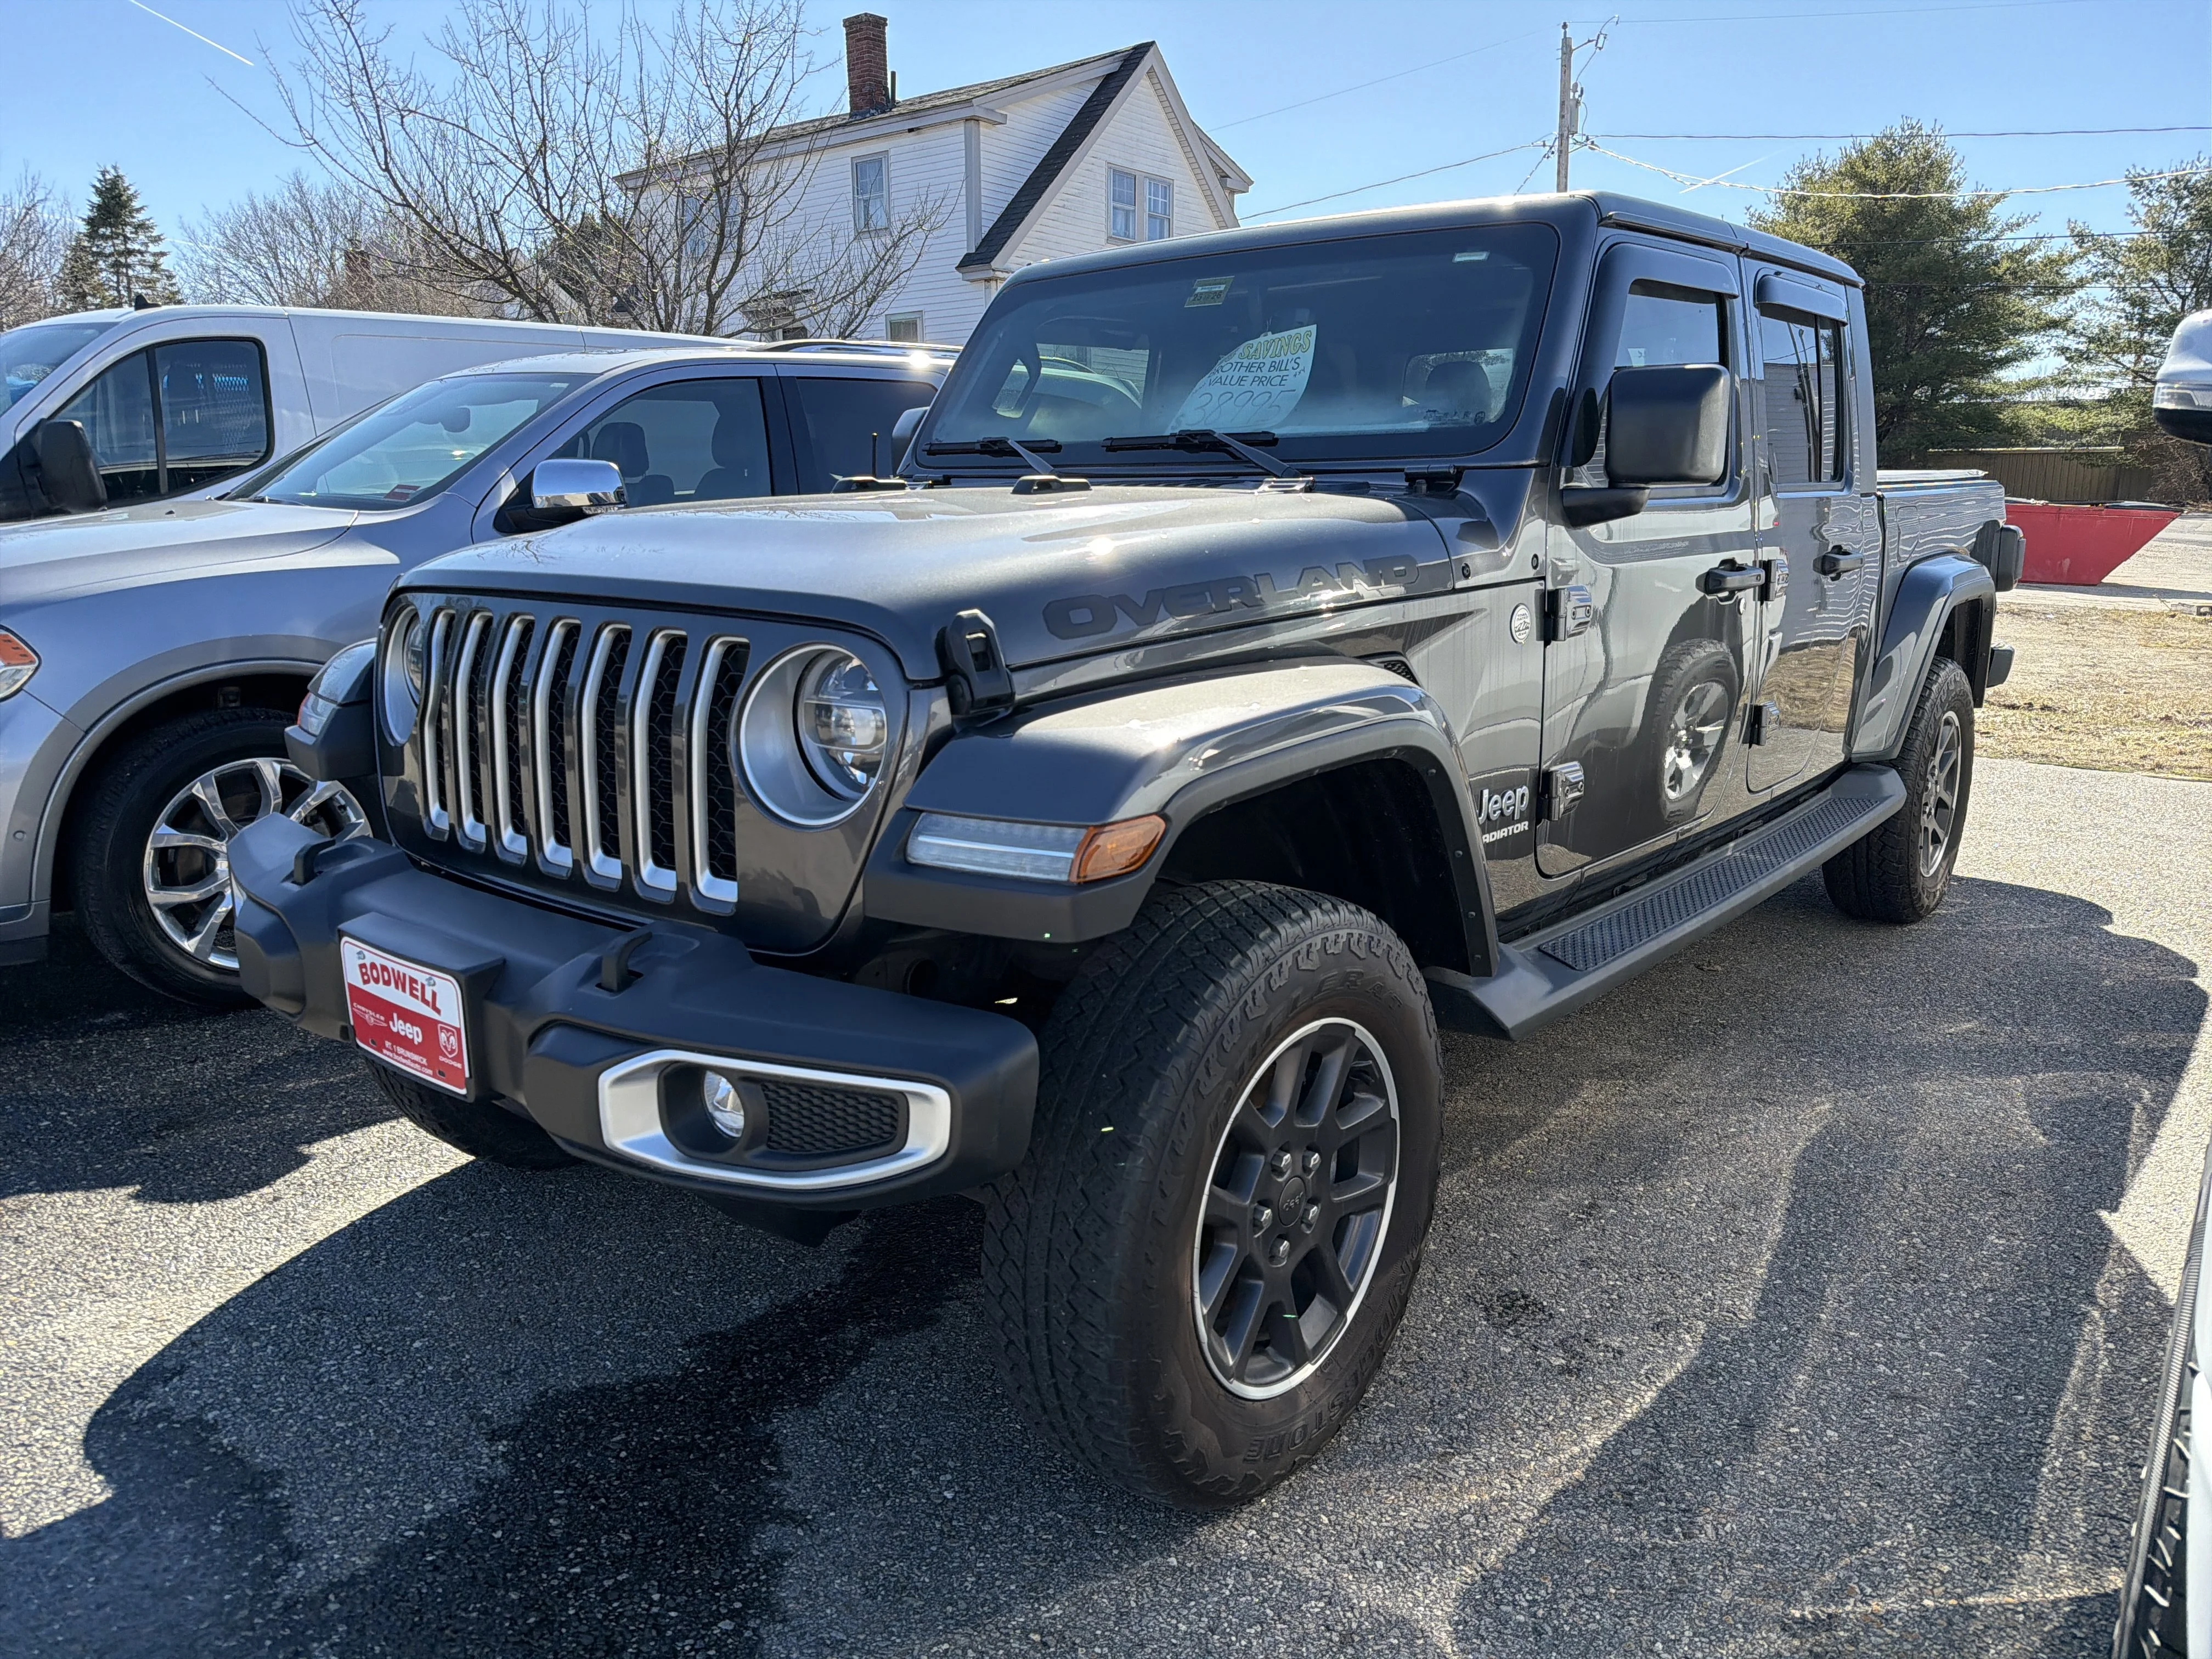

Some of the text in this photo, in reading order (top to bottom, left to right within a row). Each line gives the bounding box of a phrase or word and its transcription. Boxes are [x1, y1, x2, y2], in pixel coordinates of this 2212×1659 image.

[1238, 330, 1312, 360] SAVINGS
[1267, 356, 1301, 373] BILL'S
[1209, 375, 1289, 387] VALUE PRICE
[1186, 388, 1296, 426] 38995
[1042, 554, 1420, 640] OVERLAND
[1477, 786, 1530, 825] Jeep
[1482, 821, 1529, 844] ADIATOR
[358, 962, 442, 1017] BODWELL
[389, 1012, 422, 1045] Jeep
[439, 1055, 462, 1069] DODGE
